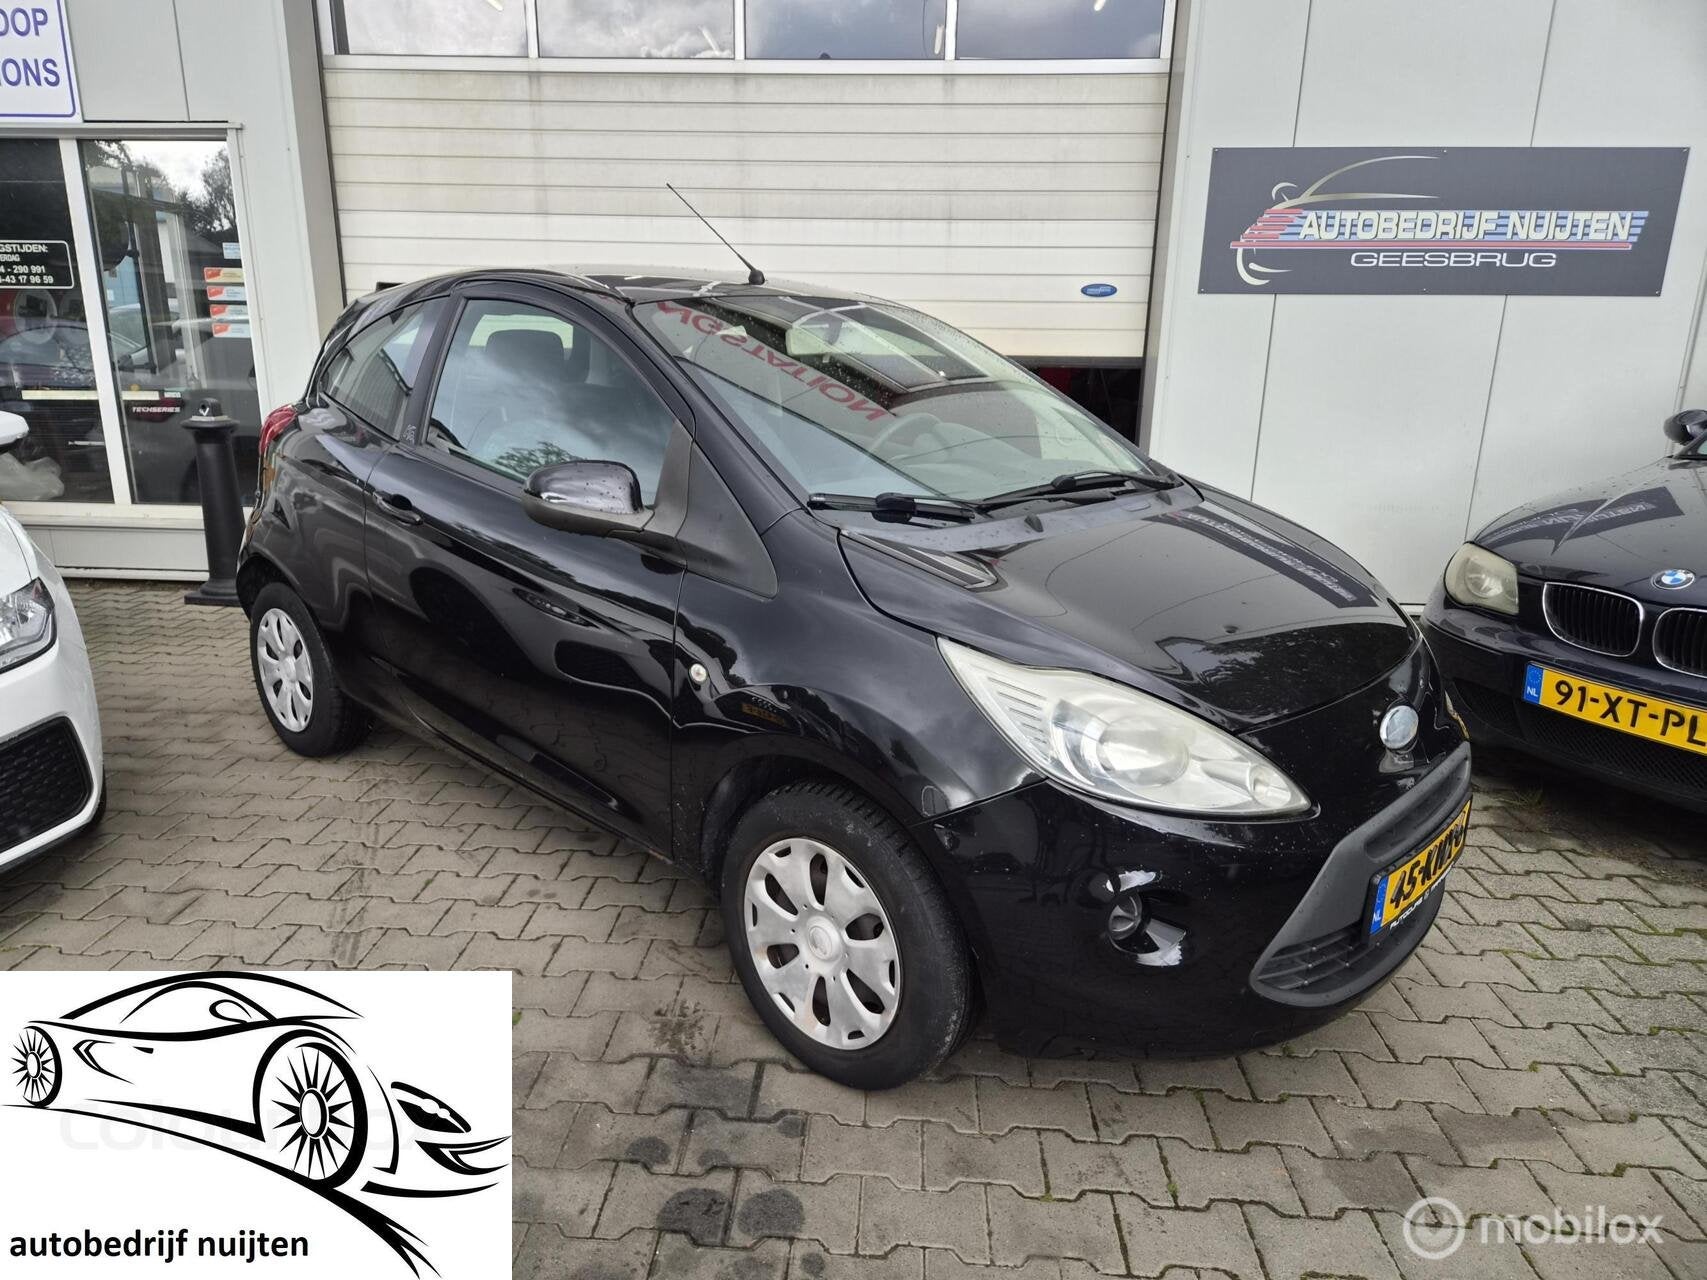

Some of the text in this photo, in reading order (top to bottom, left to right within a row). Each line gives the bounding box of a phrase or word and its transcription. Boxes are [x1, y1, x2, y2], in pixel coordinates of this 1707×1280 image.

[0, 57, 60, 87] ONS
[1298, 210, 1632, 241] AUTOBEDRIJF NUIJTEN
[13, 265, 29, 274] 290
[1350, 252, 1557, 268] GEESBRUG
[1526, 686, 1539, 698] NL
[1555, 679, 1706, 747] 91-XT-PL
